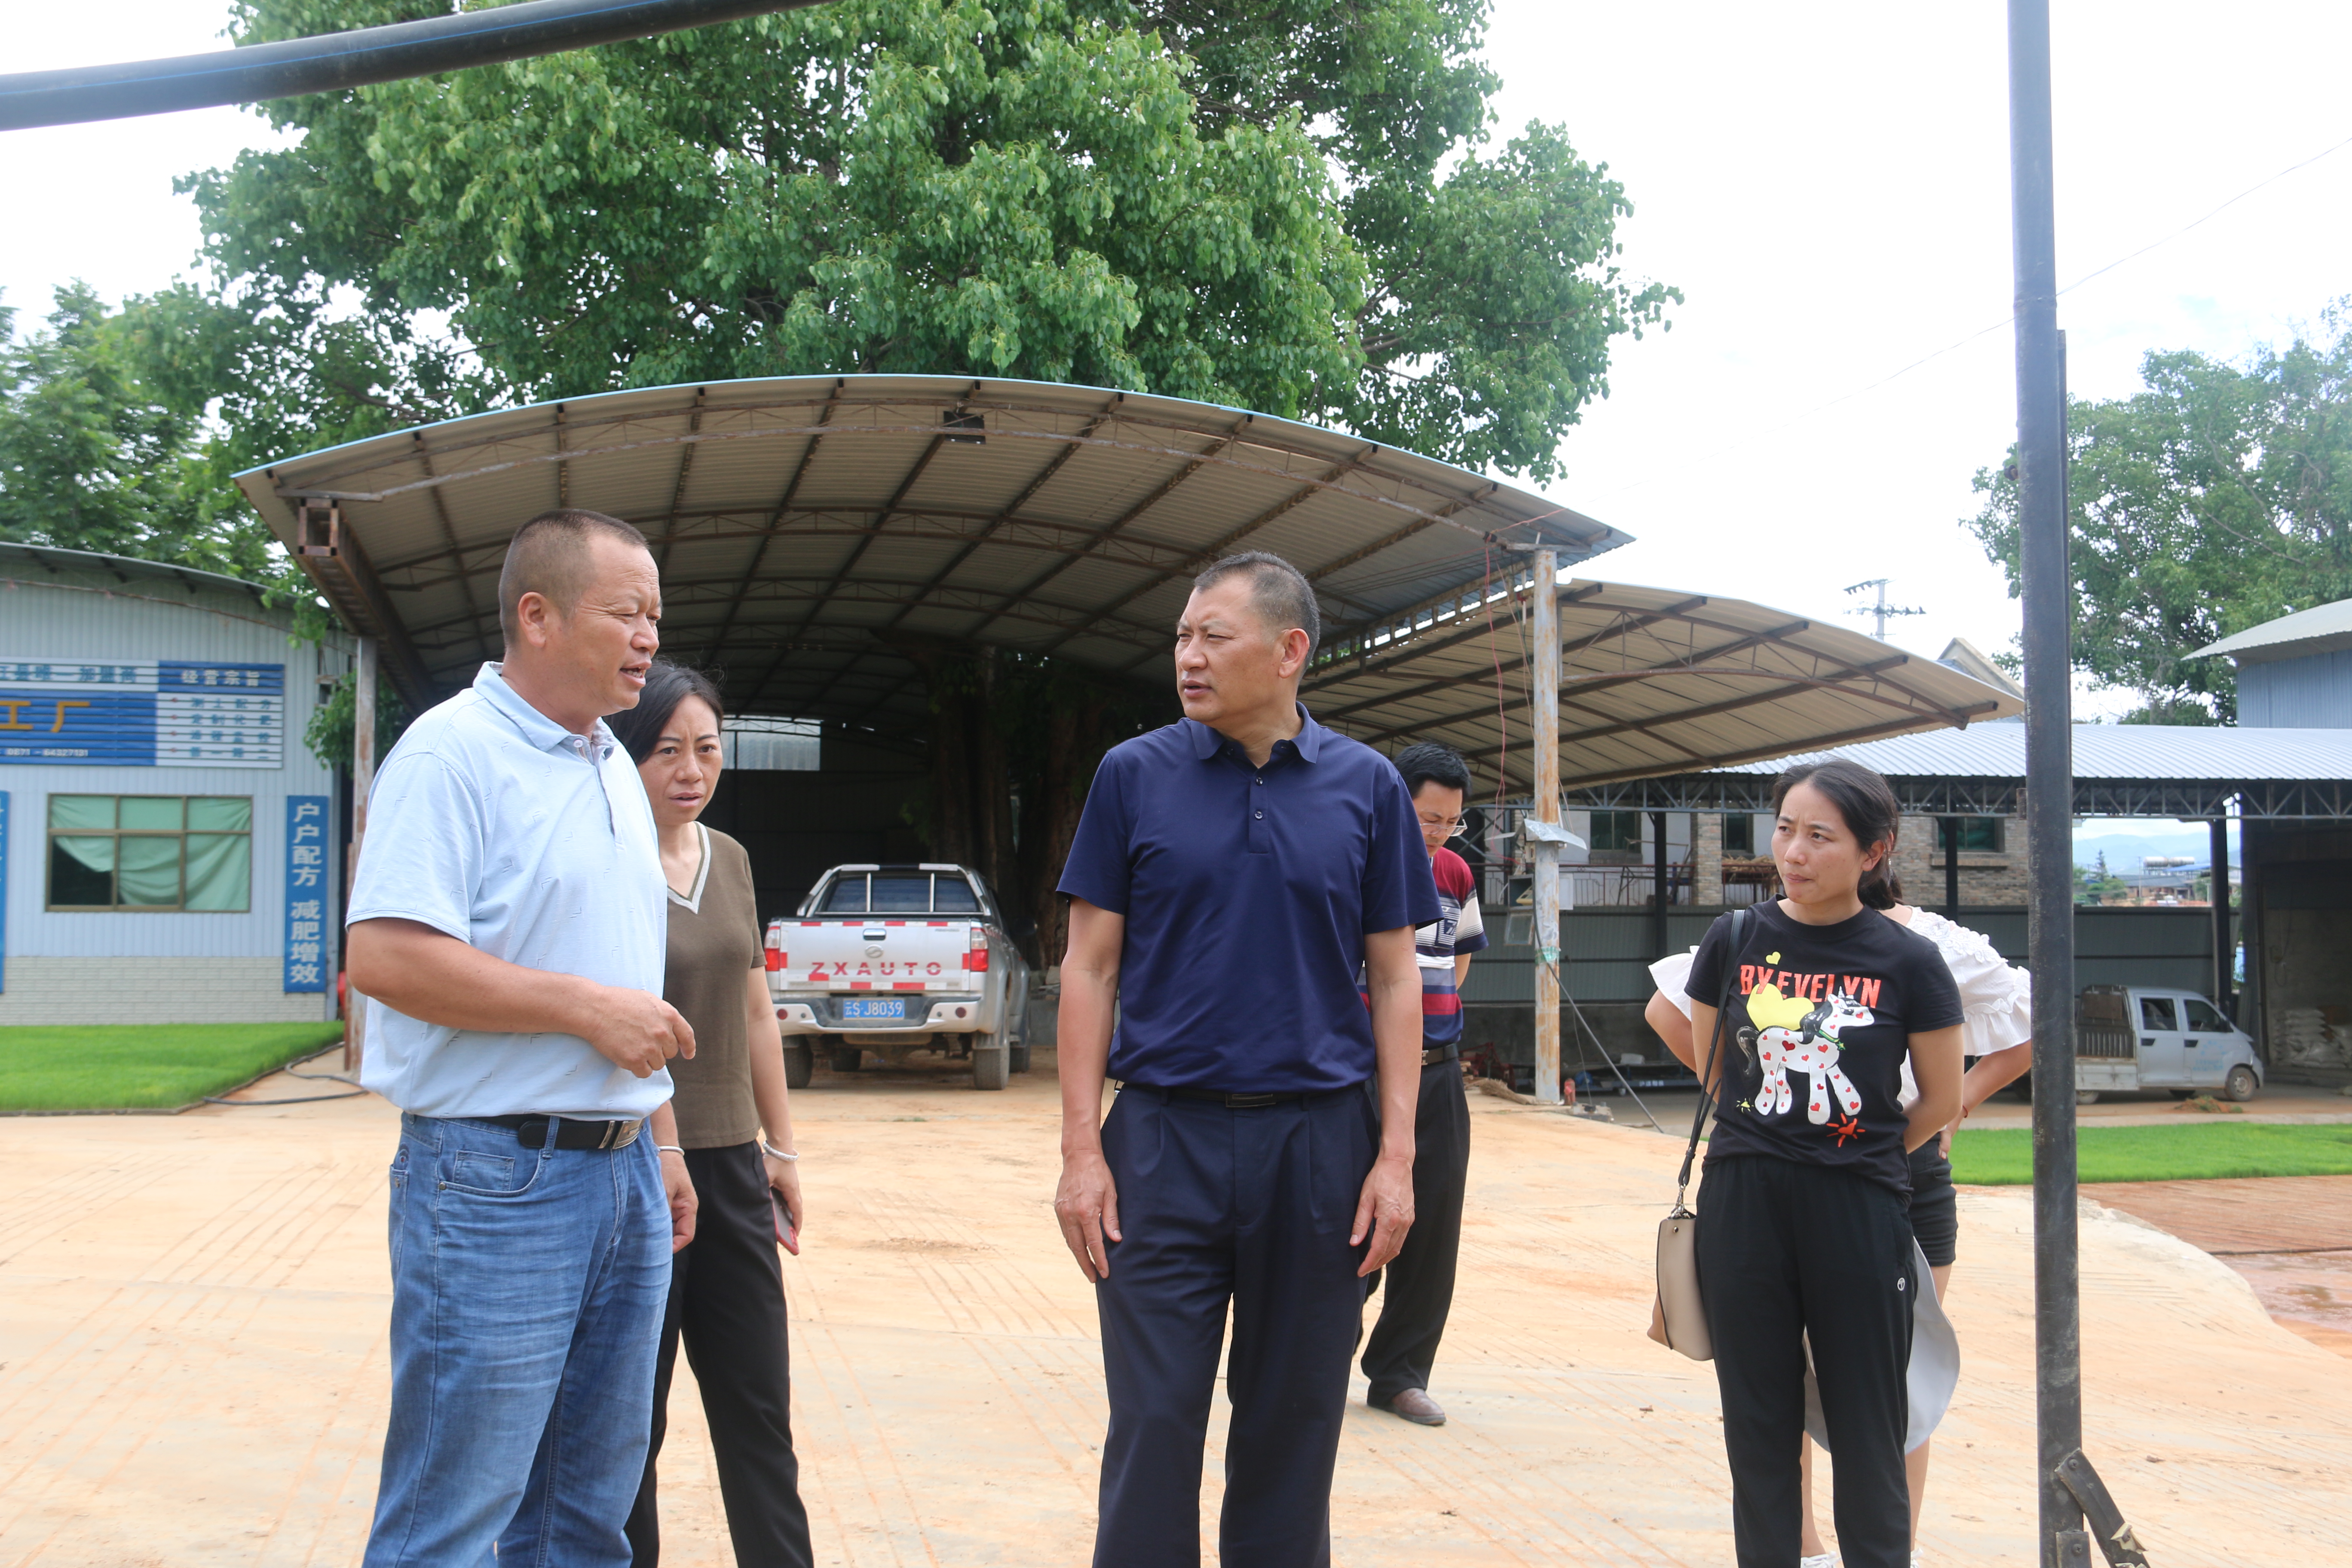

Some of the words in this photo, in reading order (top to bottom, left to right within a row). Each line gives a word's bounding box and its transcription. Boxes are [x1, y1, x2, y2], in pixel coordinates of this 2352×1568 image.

[181, 670, 260, 686] 经营宗旨
[293, 802, 322, 886] 户户配方
[290, 900, 322, 983] 减肥增效
[811, 962, 942, 976] ZXAUTO
[1740, 965, 1775, 995] BY
